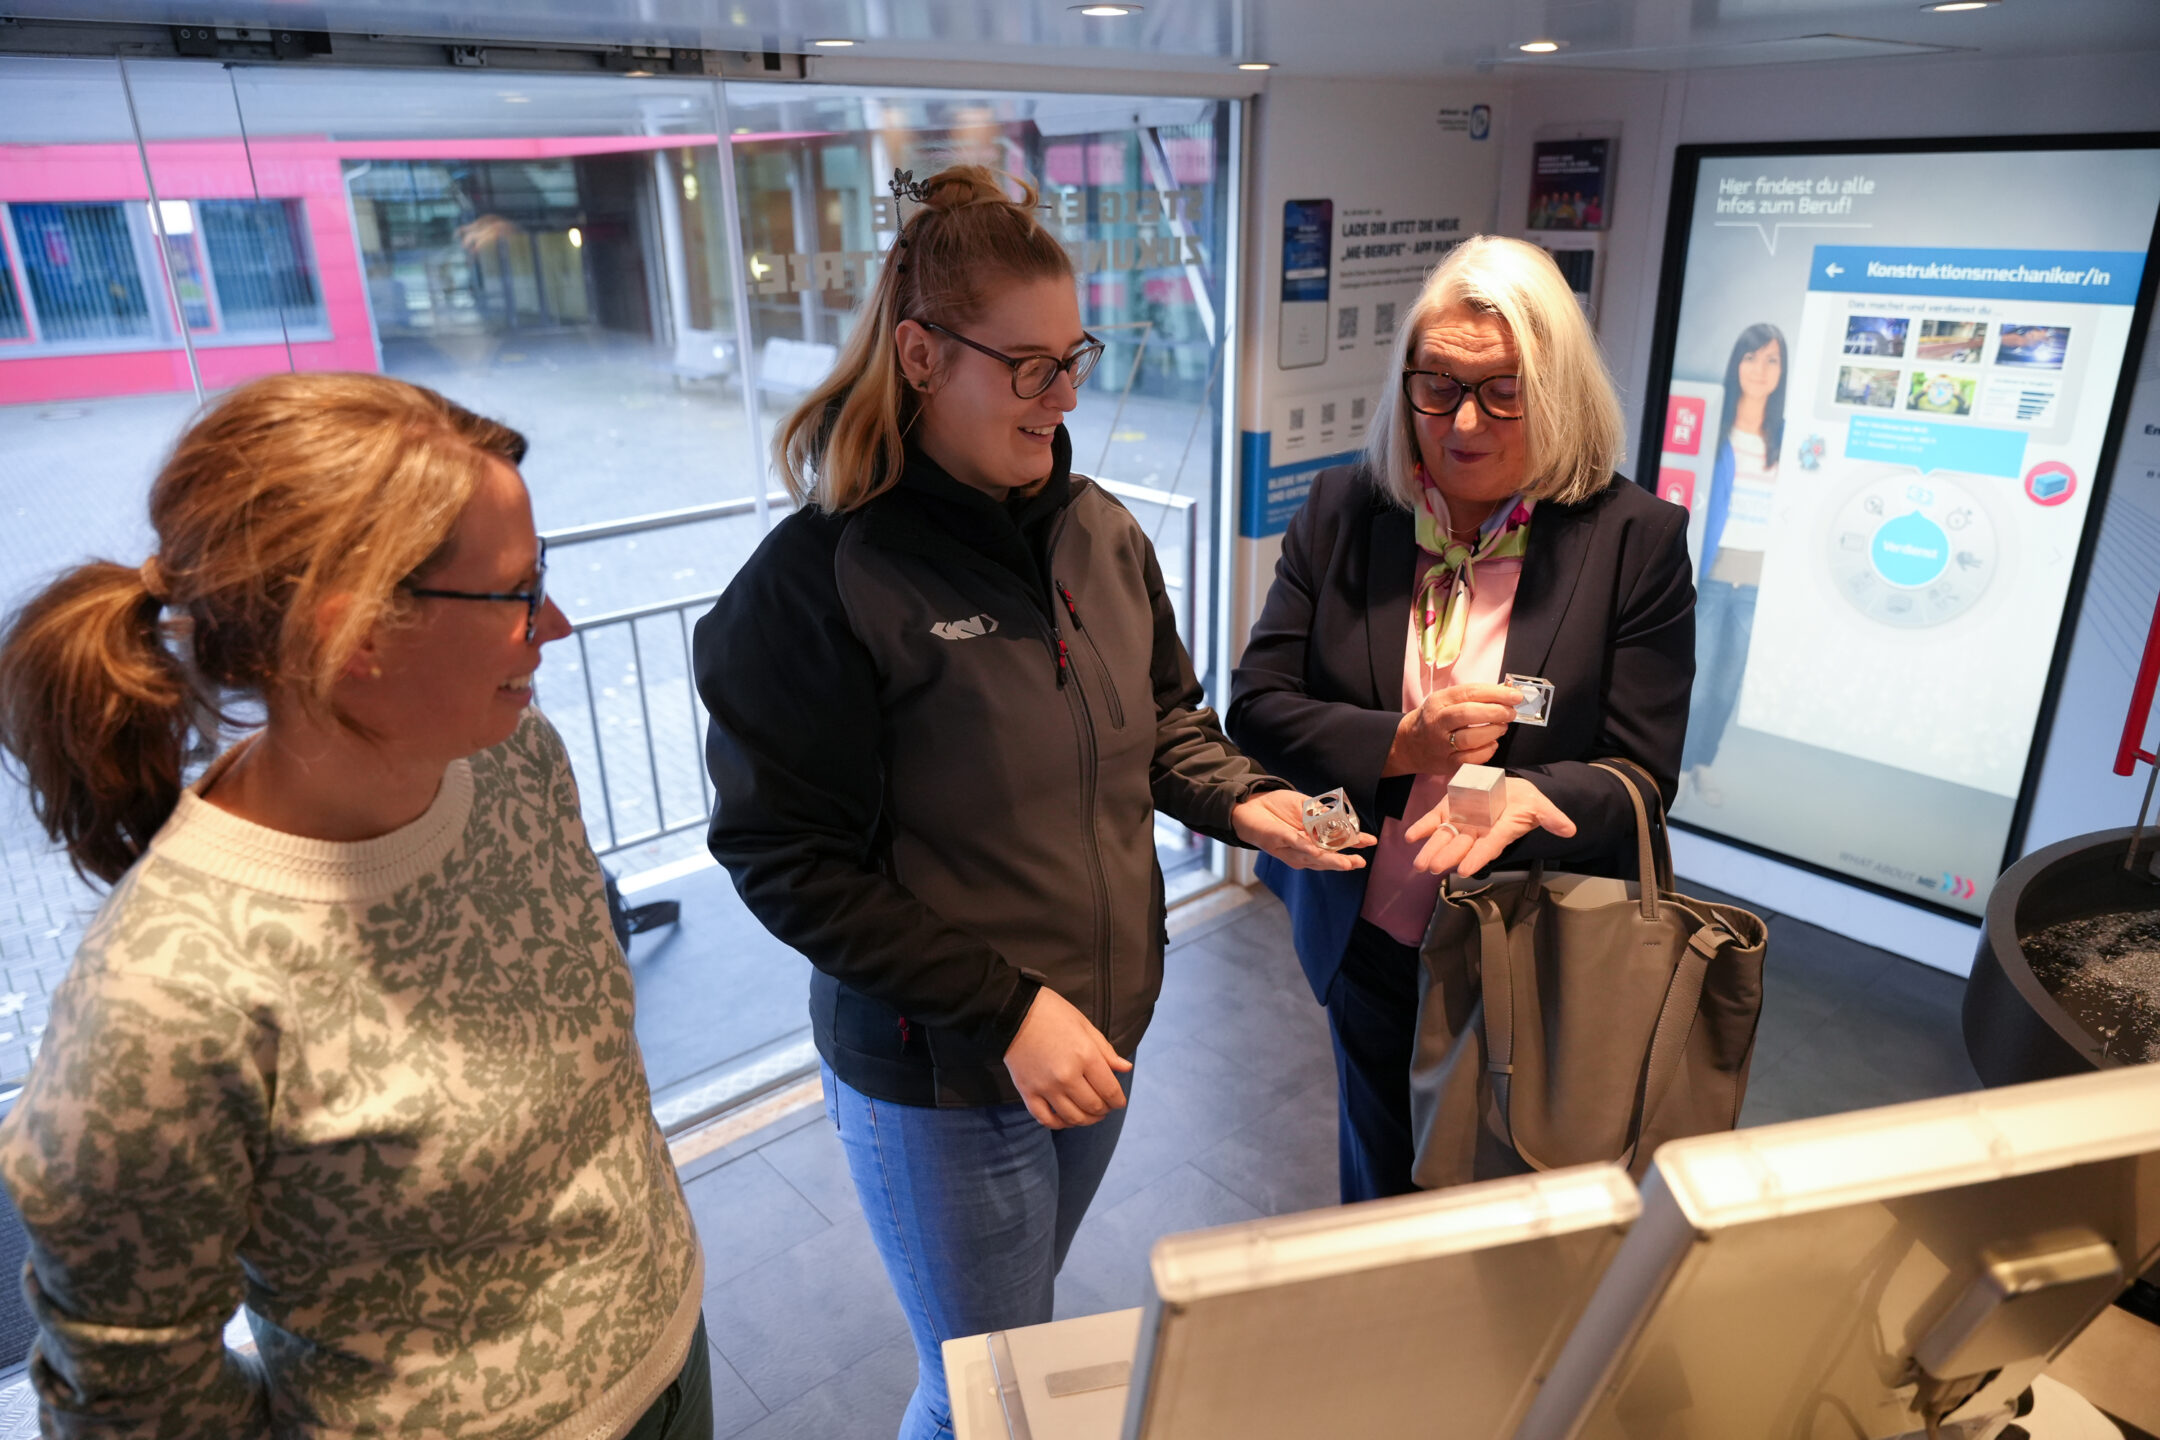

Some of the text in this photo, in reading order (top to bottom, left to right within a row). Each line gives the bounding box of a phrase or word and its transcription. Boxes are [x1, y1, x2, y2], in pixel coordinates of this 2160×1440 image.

[1719, 176, 1875, 195] Hier findest du alle
[1716, 196, 1853, 214] Infos zum Beruf!
[1867, 261, 2111, 286] Konstruktionsmechaniker/in
